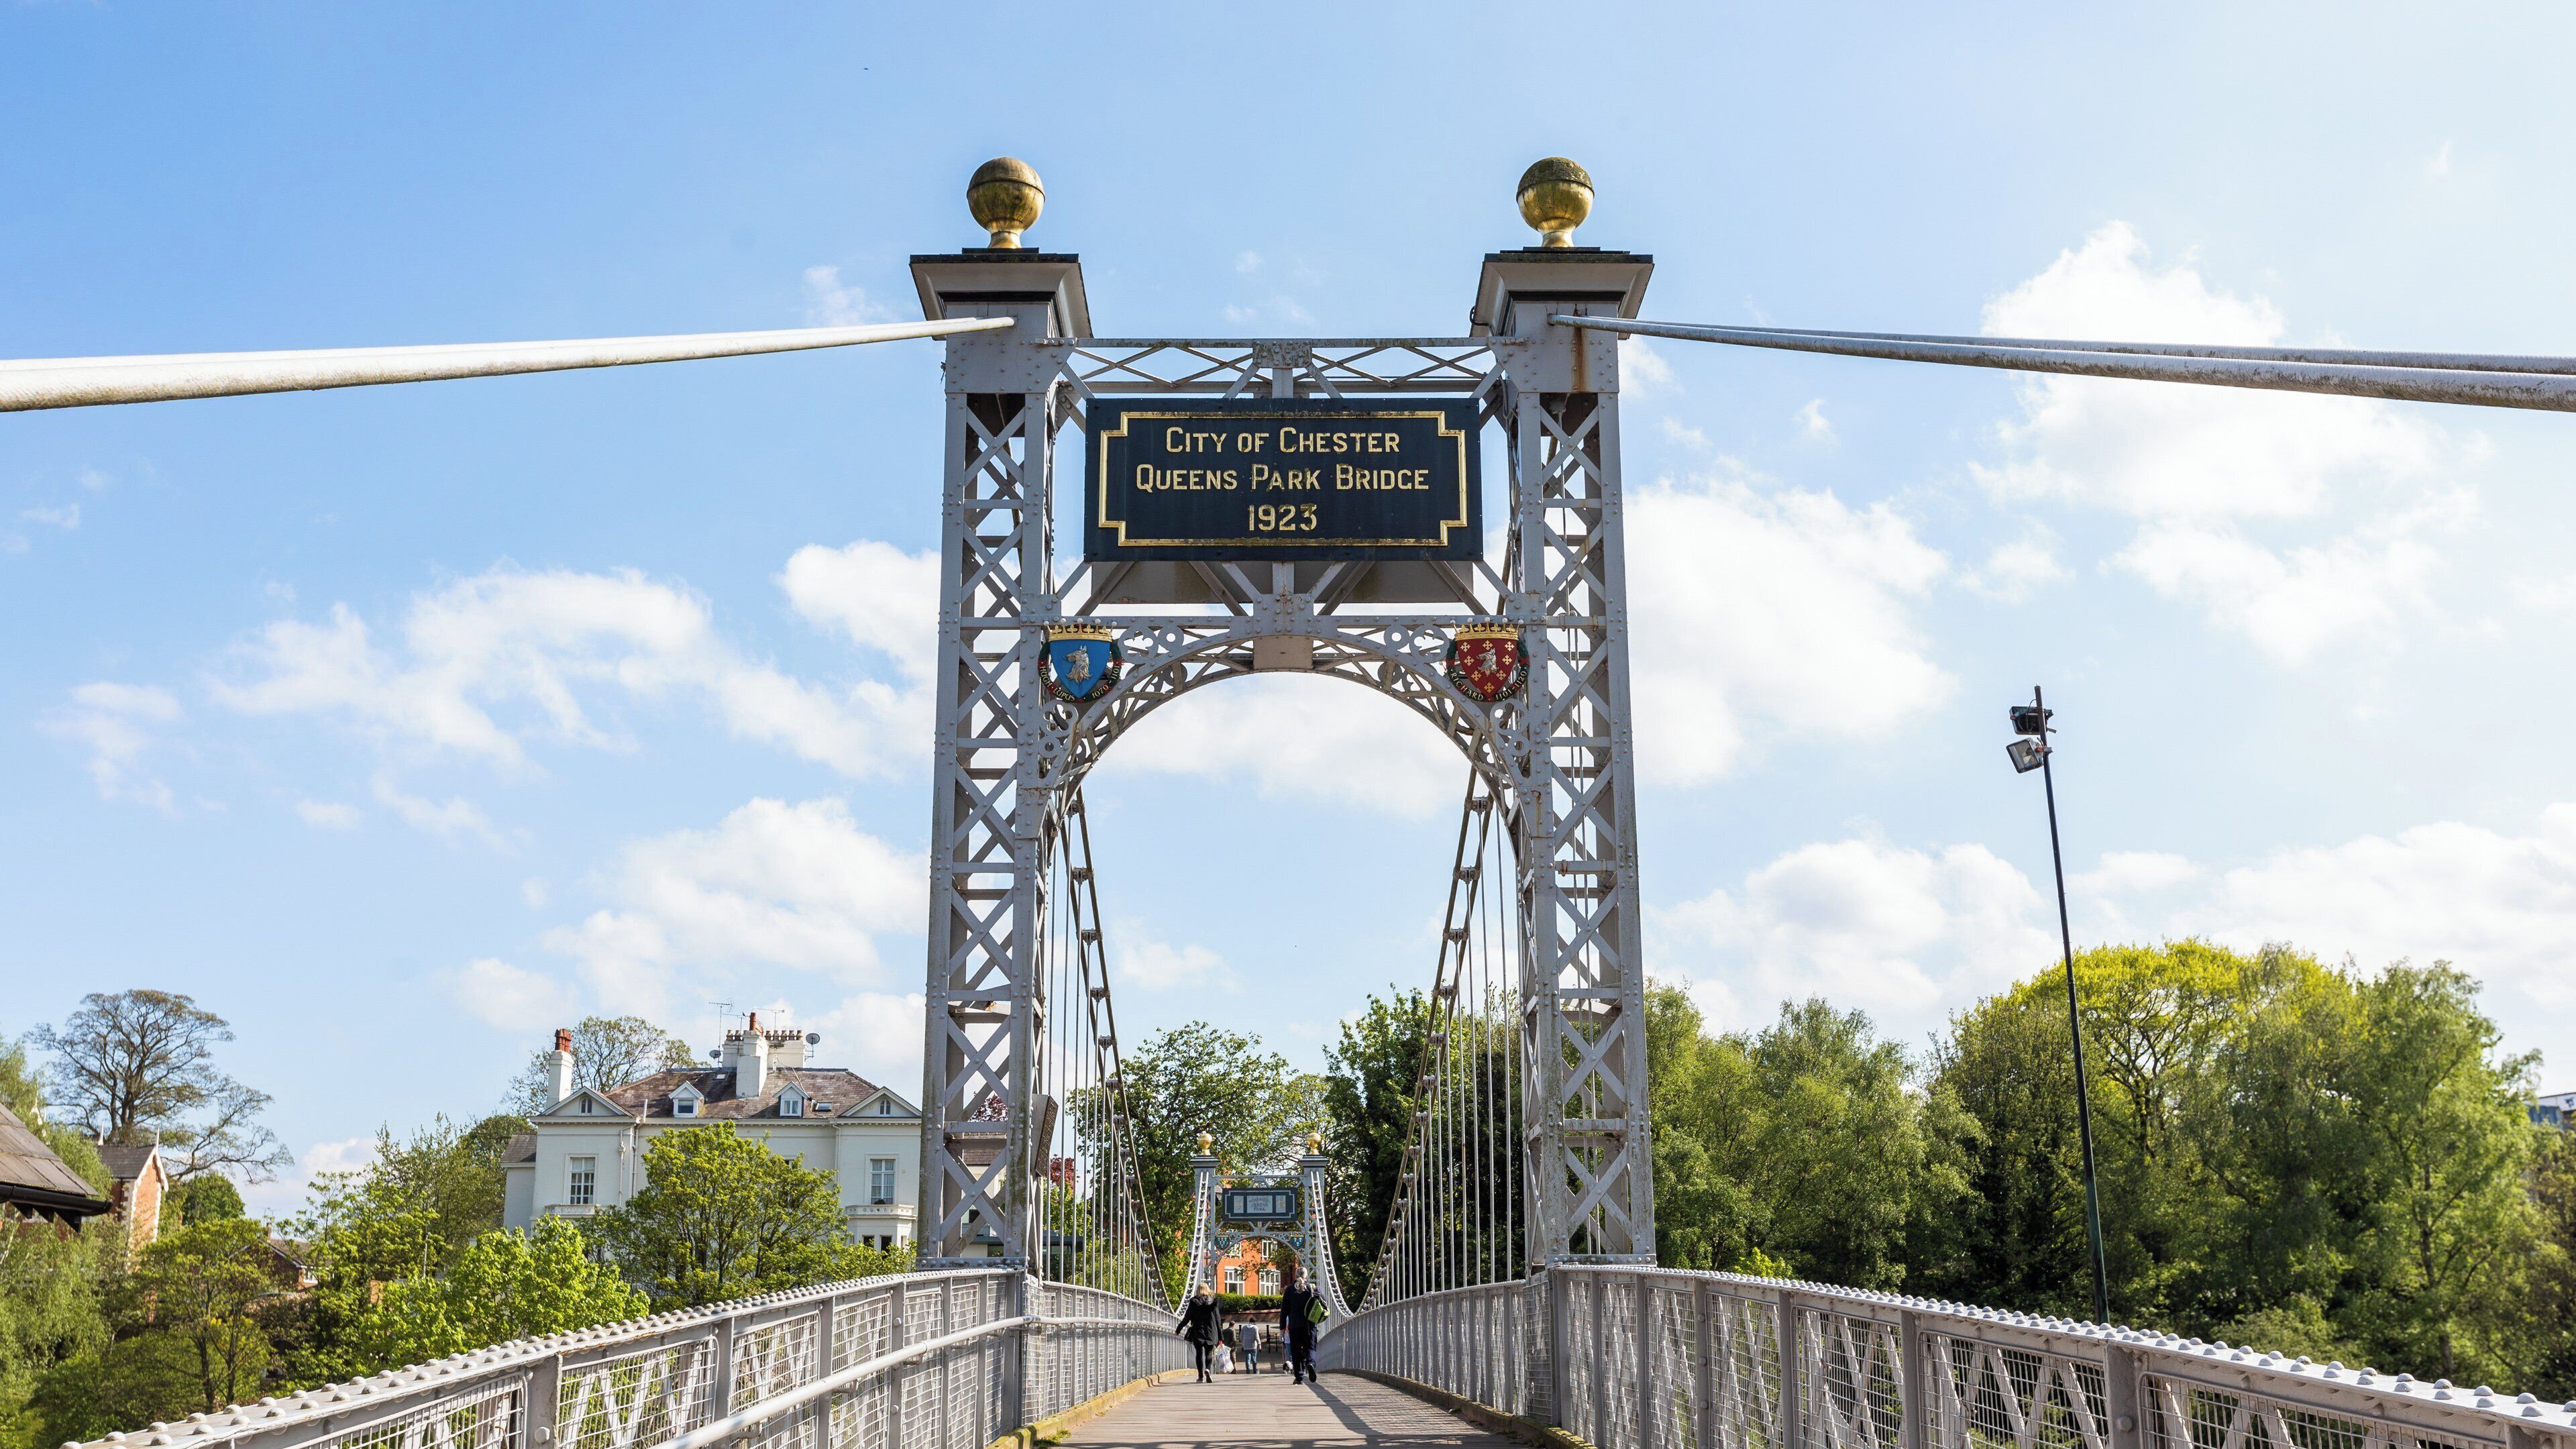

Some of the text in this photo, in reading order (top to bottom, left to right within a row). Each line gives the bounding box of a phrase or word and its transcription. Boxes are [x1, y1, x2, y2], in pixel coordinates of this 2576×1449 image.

[1166, 427, 1227, 453] CITY
[1279, 427, 1400, 453] CHESTER
[1136, 464, 1429, 493] QUEENS PARK BRIDGE
[1248, 504, 1317, 531] 1923
[1039, 666, 1053, 688] HUGH
[1053, 688, 1075, 702] LUPUS
[1450, 672, 1484, 700] RICHARD
